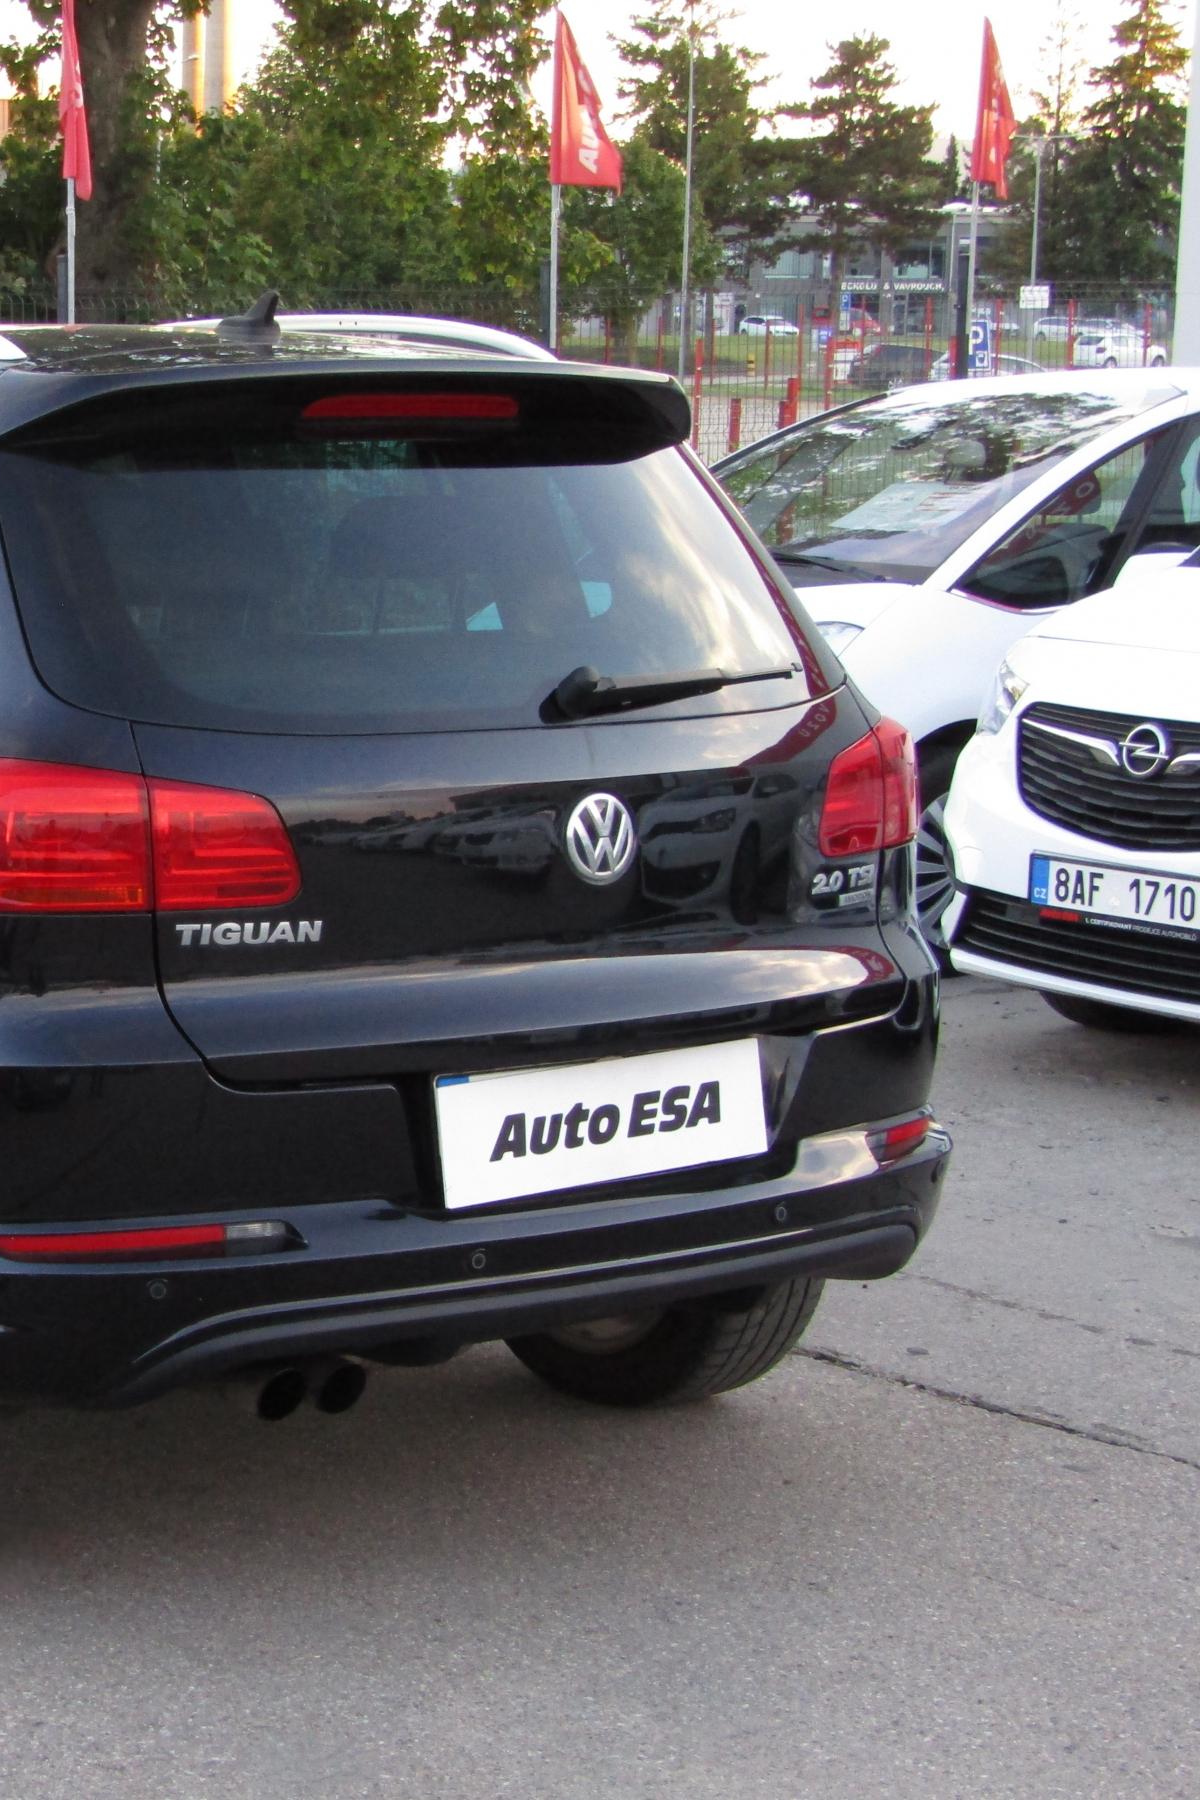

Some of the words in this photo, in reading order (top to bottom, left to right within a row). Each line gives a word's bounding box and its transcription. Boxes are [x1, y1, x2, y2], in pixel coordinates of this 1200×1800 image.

[968, 325, 984, 356] P
[1033, 887, 1047, 899] CZ
[1054, 867, 1104, 907] 8AF
[1129, 878, 1196, 922] 1710
[175, 920, 323, 947] TIGUAN
[489, 1102, 621, 1163] Auto
[627, 1080, 721, 1139] ESA
